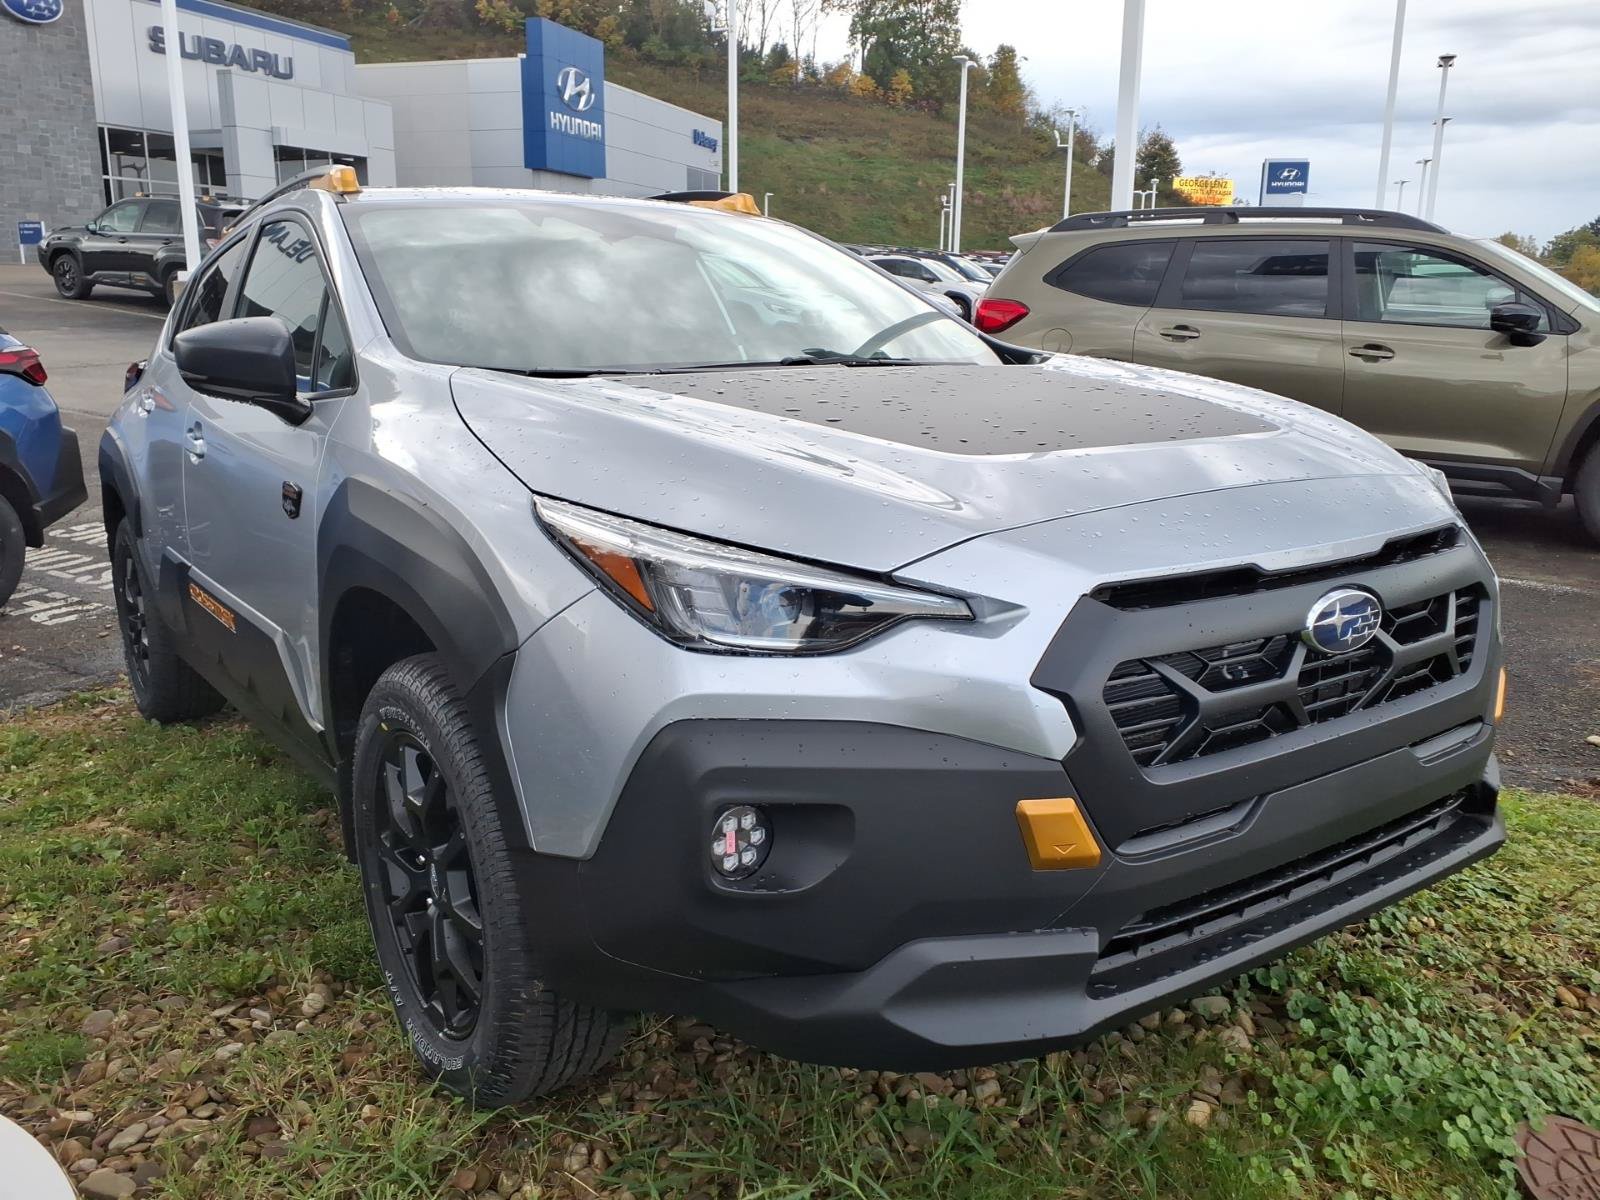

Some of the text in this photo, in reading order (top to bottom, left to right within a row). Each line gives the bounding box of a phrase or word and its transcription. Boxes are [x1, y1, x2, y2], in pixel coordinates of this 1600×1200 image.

[148, 25, 294, 80] SUBARU
[550, 111, 602, 141] HYUNDAI
[1179, 179, 1209, 188] GEORGE
